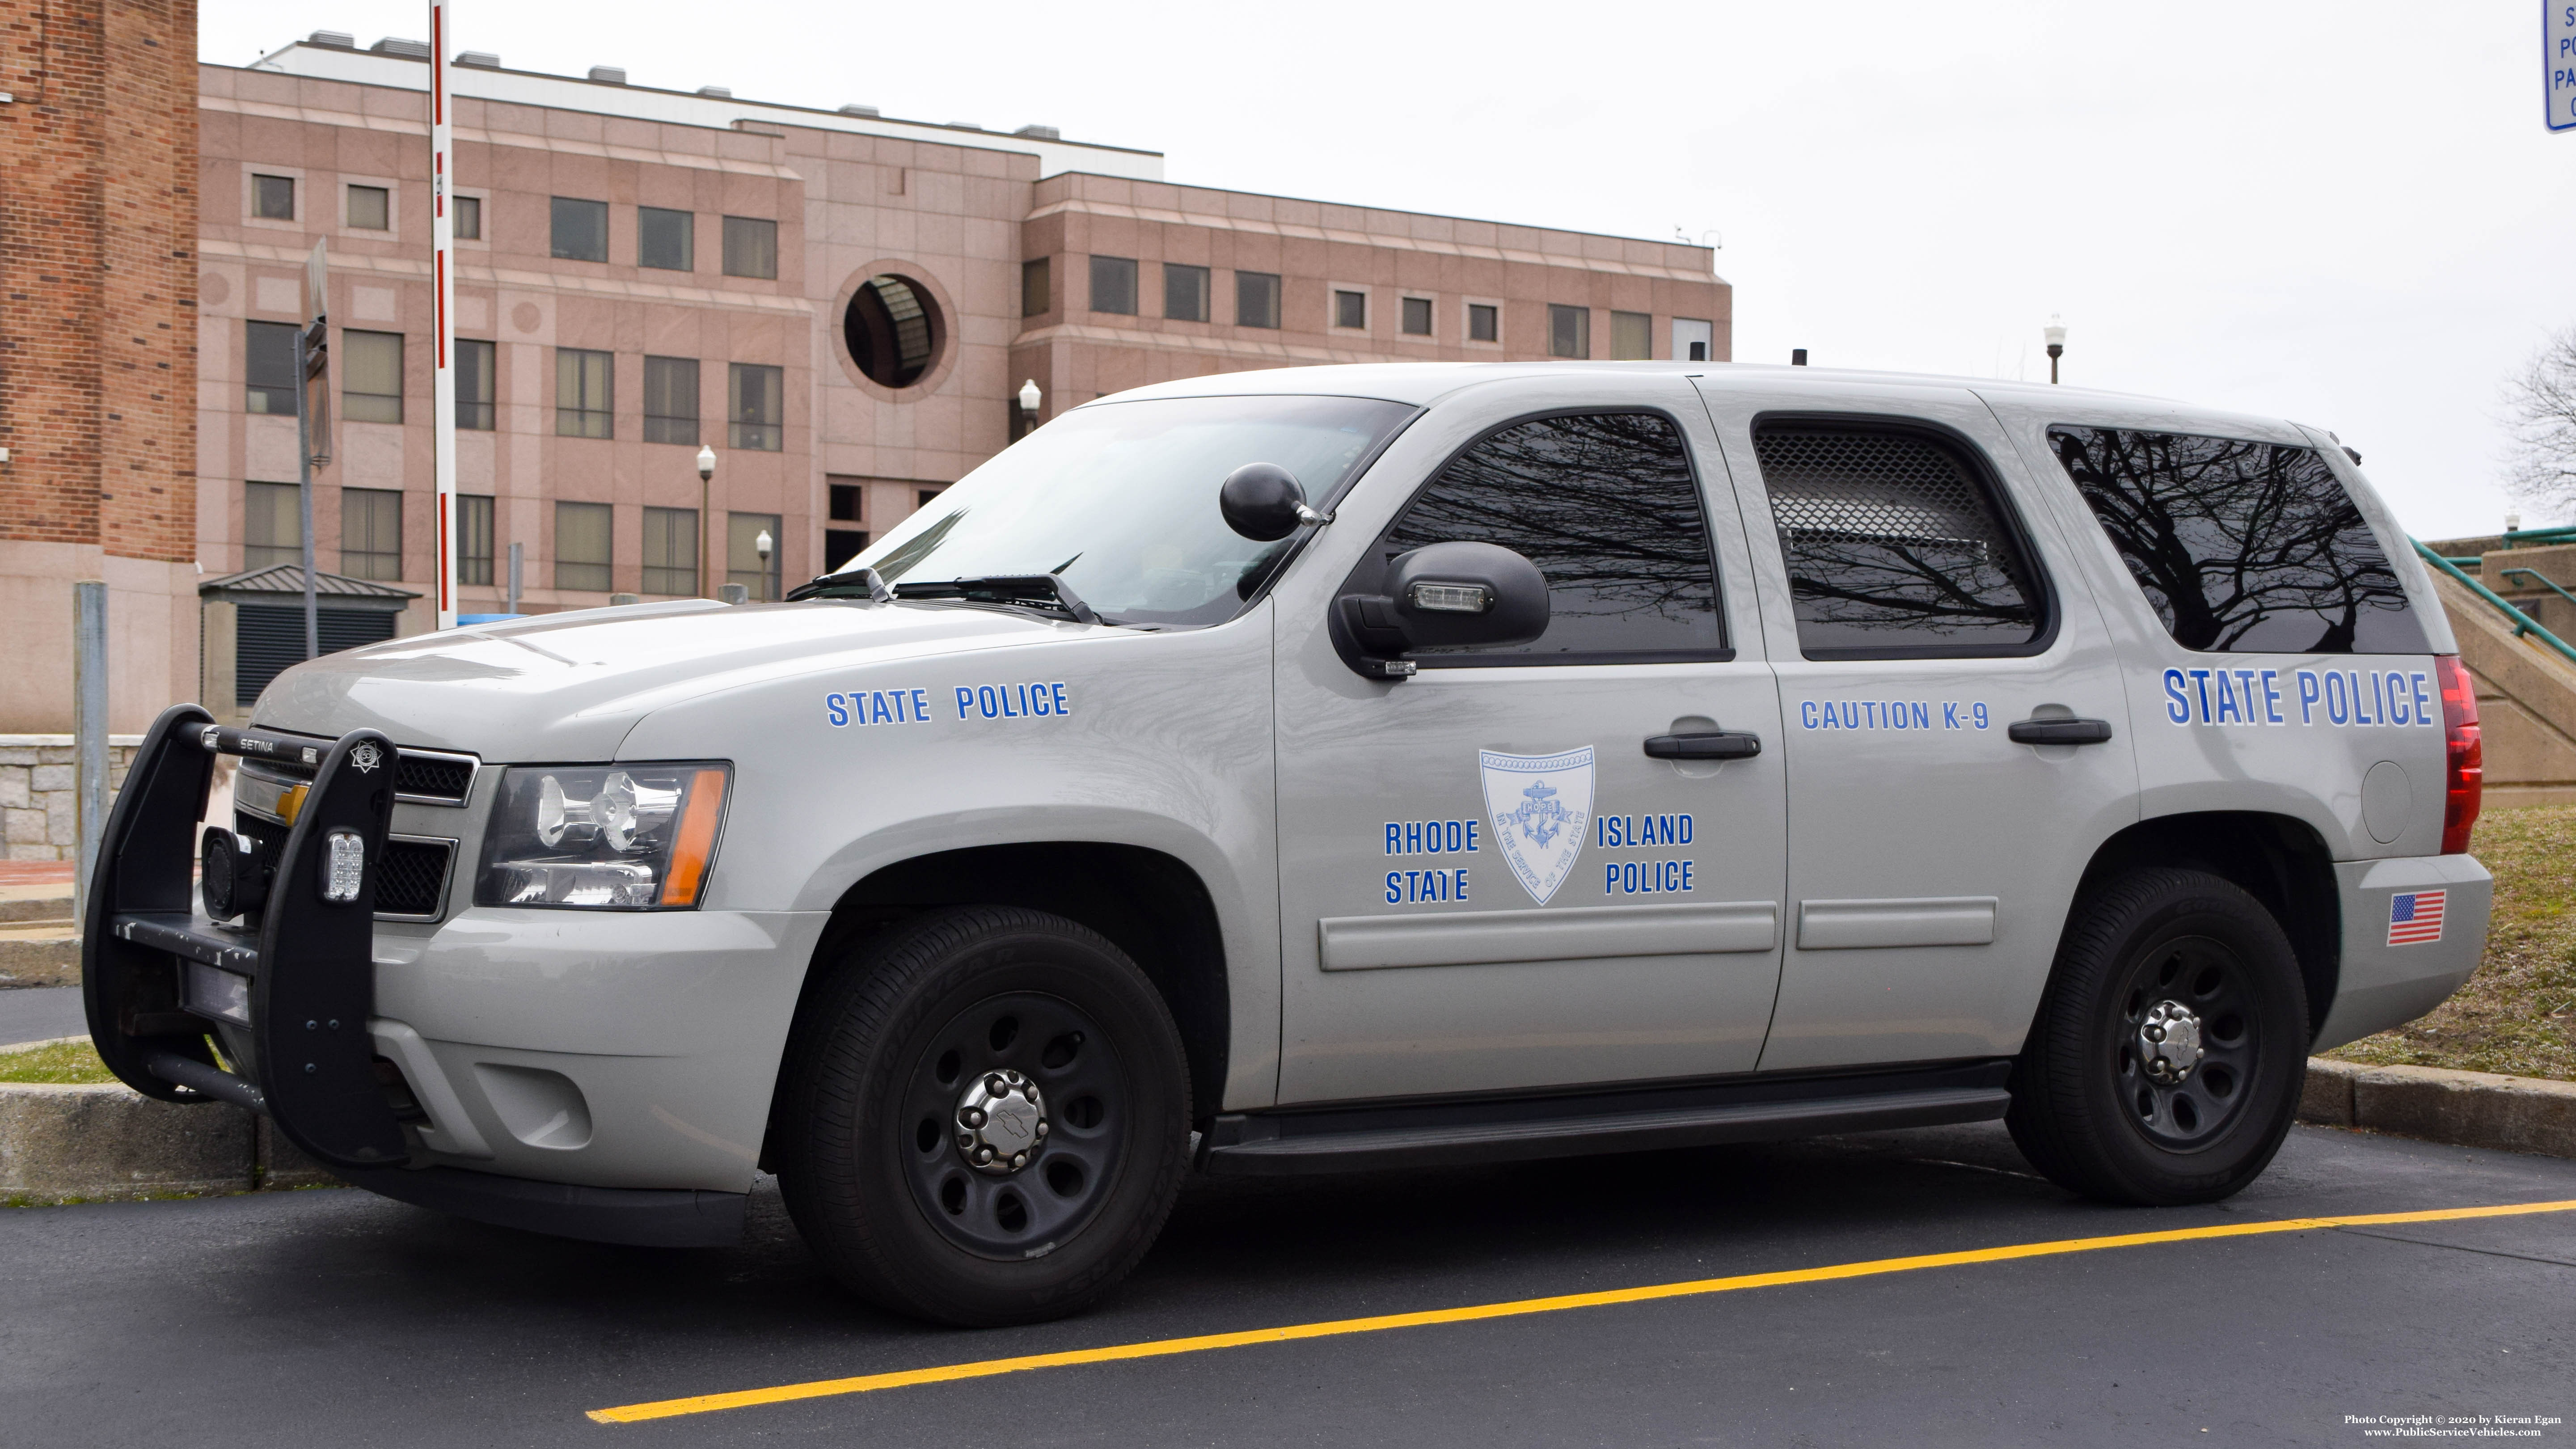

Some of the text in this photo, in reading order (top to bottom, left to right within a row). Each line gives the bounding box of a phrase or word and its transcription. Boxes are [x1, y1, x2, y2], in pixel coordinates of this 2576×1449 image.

[826, 681, 1070, 728] STATE POLICE
[1800, 700, 1989, 731] CAUTION K-9
[2162, 667, 2433, 727] STATE POLICE
[241, 738, 273, 753] SETINA
[1527, 803, 1552, 811] HOPE
[1385, 813, 1693, 856] RHODE ISLAND
[1497, 810, 1585, 889] IN THE SERVICE OF THE STATE
[1385, 860, 1694, 906] STATE POLICE
